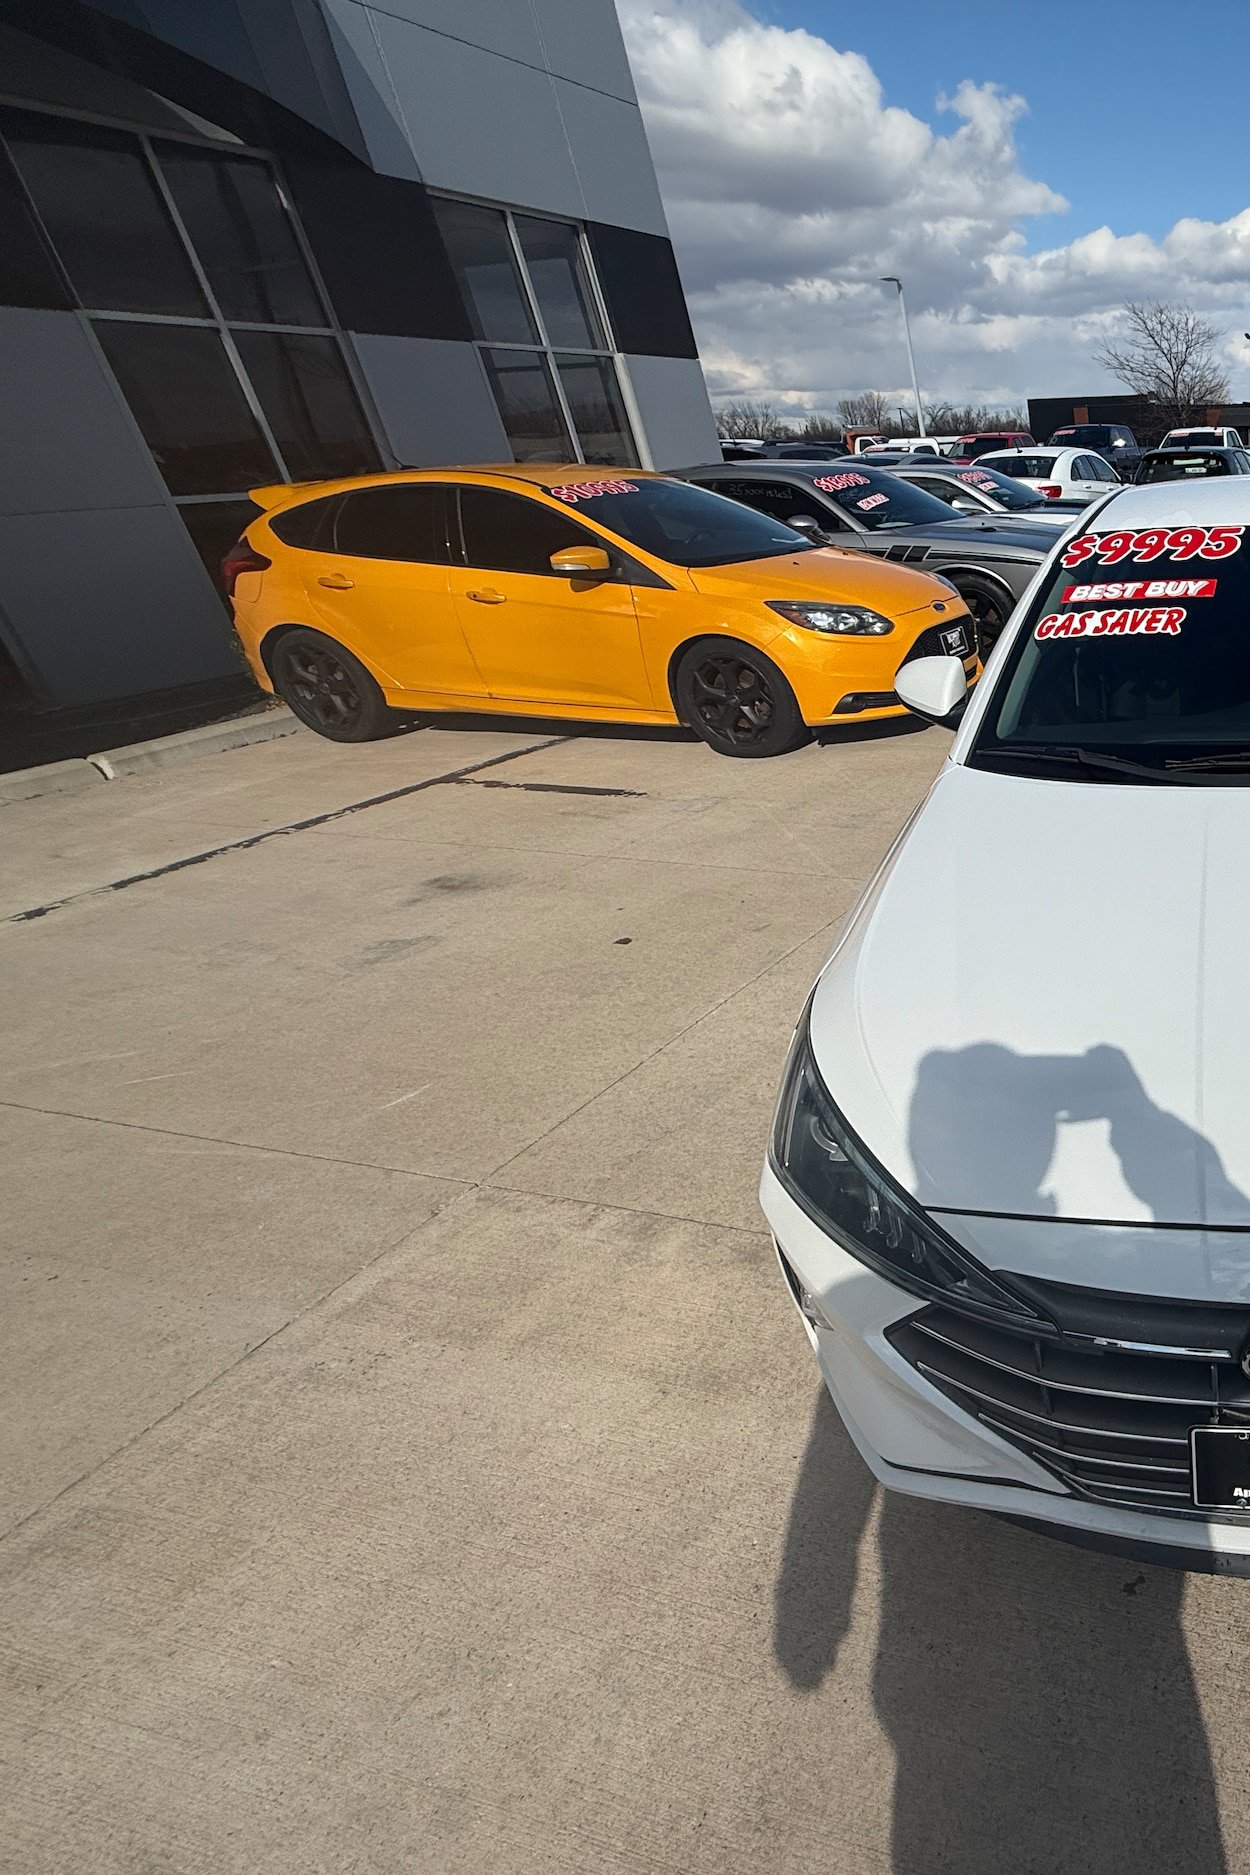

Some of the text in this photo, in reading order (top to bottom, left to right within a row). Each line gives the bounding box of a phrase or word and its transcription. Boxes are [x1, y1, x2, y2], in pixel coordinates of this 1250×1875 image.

[1061, 526, 1245, 568] $9995
[1069, 579, 1209, 601] BEST BUY
[1034, 607, 1186, 640] GAS SAVER
